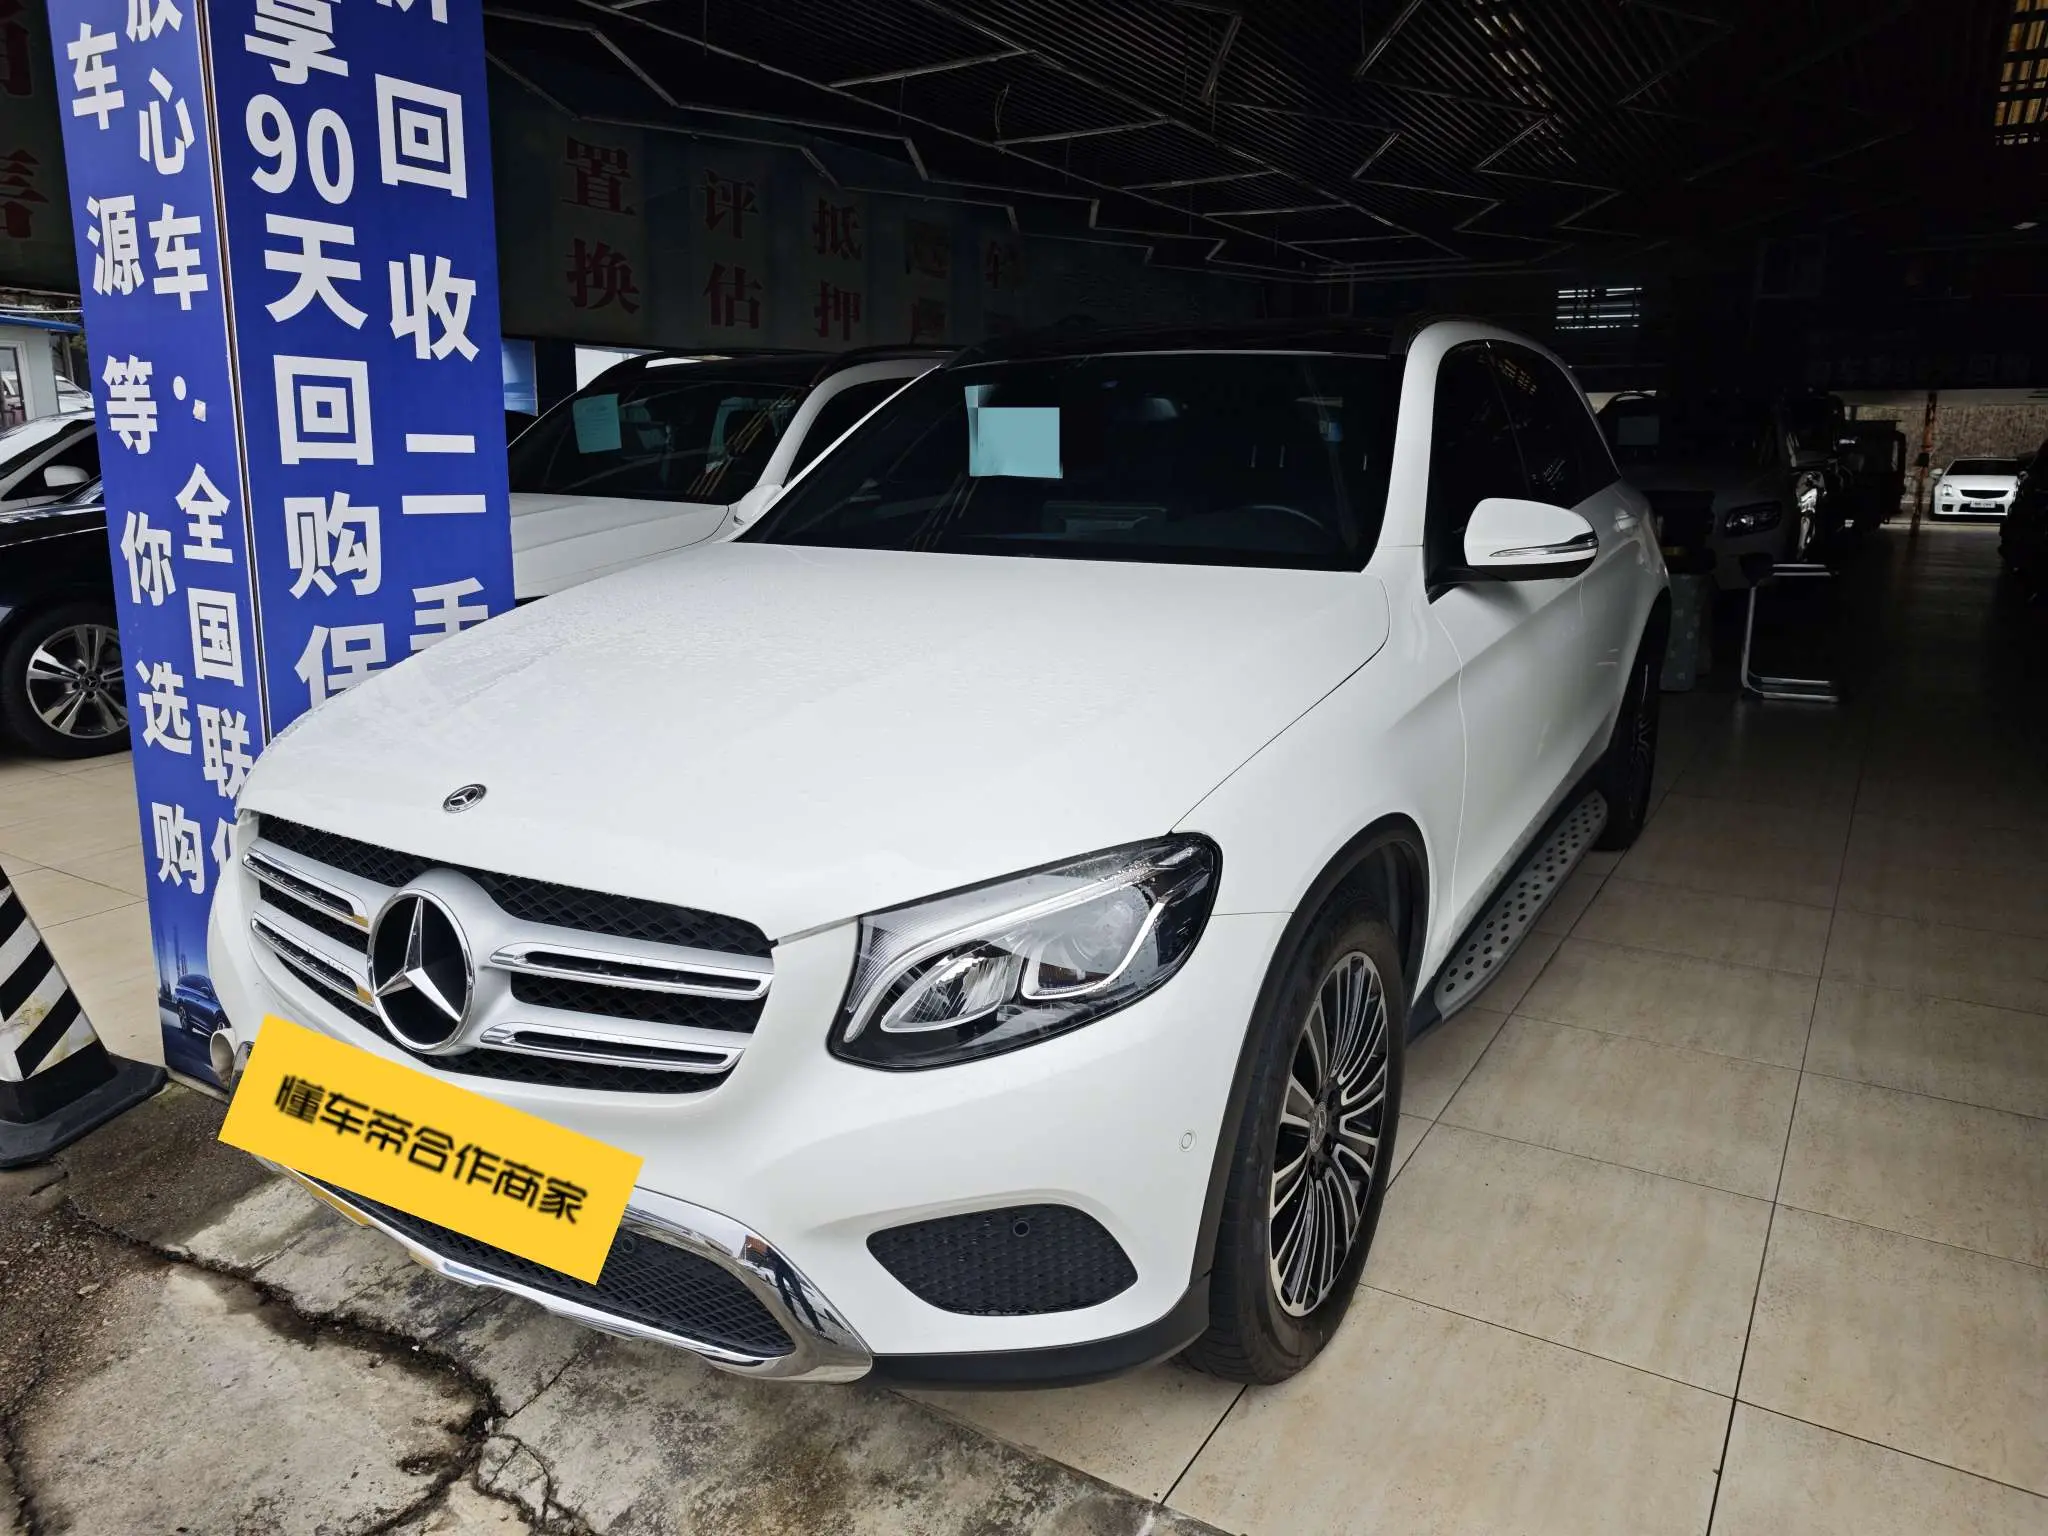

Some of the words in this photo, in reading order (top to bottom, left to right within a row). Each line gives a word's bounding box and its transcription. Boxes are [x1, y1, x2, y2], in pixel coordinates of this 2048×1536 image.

[374, 0, 489, 654] 回收二手
[561, 134, 640, 314] 置换
[703, 168, 763, 330] 评估
[812, 196, 863, 341] 抵押
[67, 23, 205, 894] 车源等你选购
[125, 0, 254, 877] 心车·全国联
